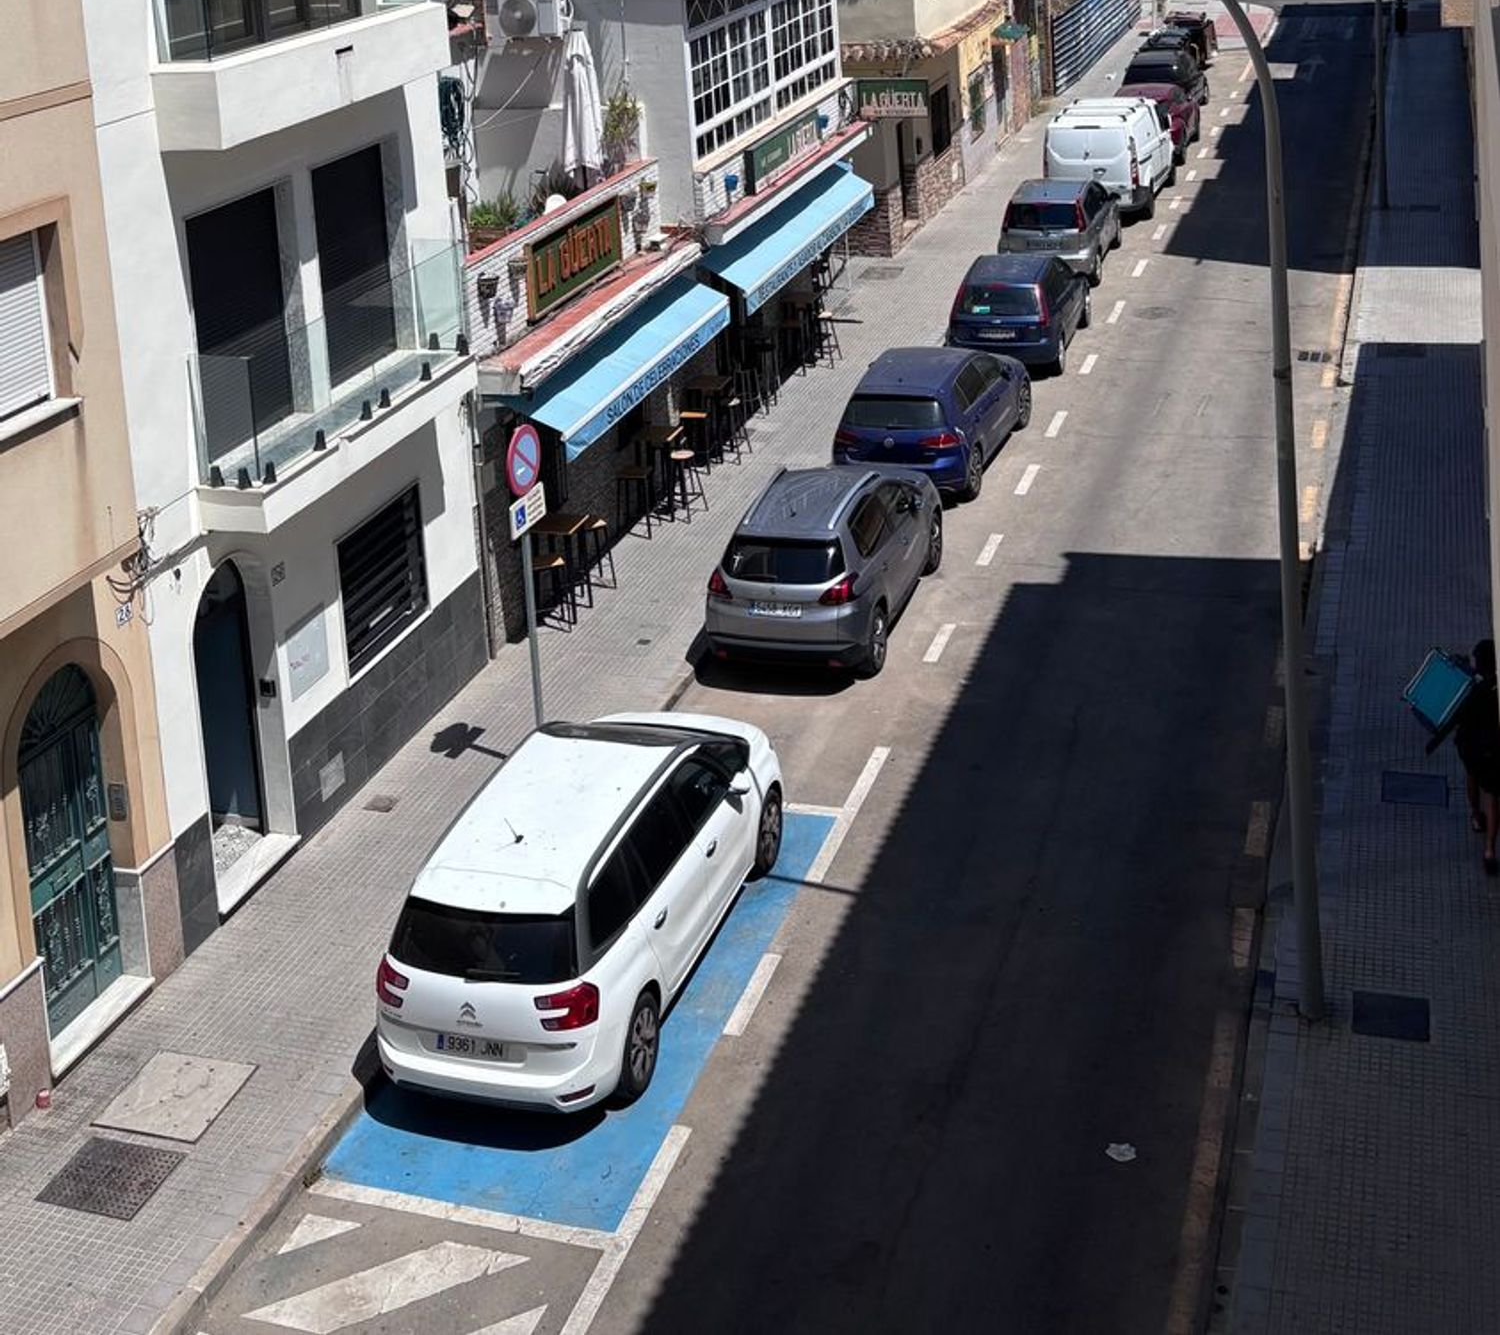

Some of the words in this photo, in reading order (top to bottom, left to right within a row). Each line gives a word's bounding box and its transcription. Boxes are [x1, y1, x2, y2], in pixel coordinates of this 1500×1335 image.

[863, 92, 878, 107] LA
[879, 86, 925, 107] GÜERTA
[536, 249, 556, 294] LA
[559, 216, 611, 279] GÜERTA
[448, 1036, 475, 1055] 9361
[481, 1042, 503, 1057] JNN
